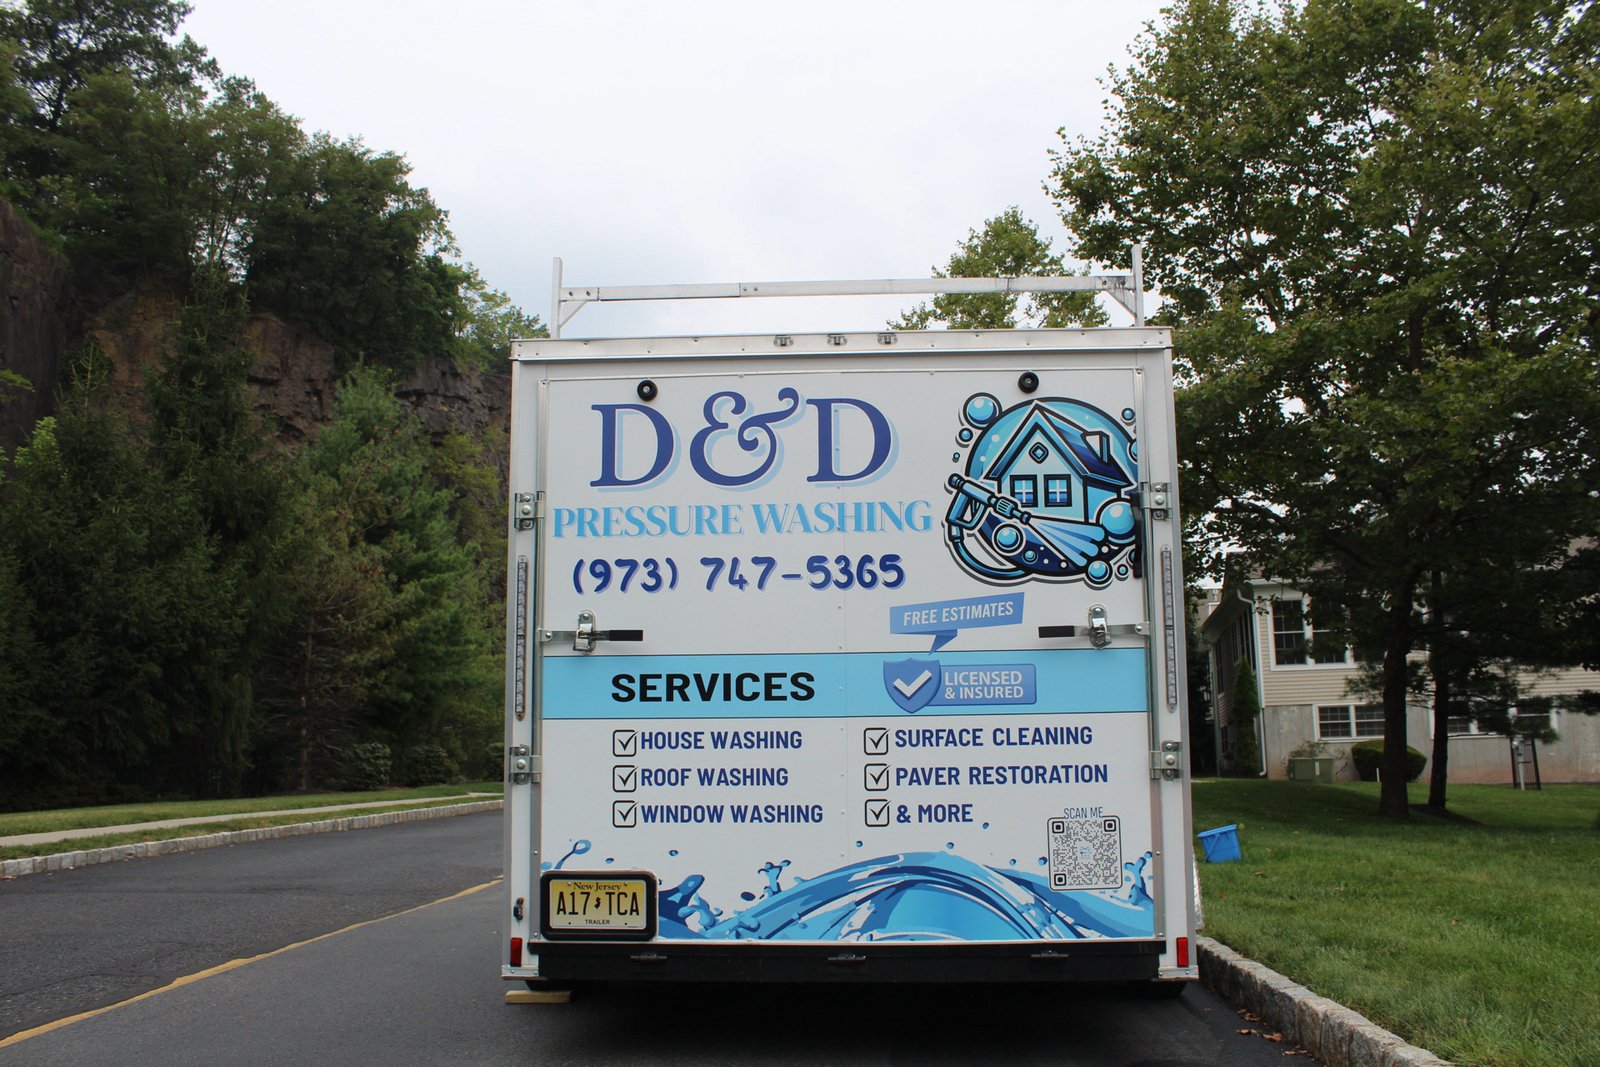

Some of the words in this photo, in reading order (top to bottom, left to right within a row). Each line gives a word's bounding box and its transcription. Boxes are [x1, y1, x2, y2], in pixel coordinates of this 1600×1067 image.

[589, 387, 899, 491] D&D
[553, 503, 745, 539] PRESSURE
[751, 500, 933, 537] WASHING
[573, 557, 679, 594] (973)
[700, 554, 906, 592] 747-5365
[903, 611, 937, 626] FREE
[942, 601, 1014, 623] ESTIMATES
[611, 672, 815, 702] SERVICES
[944, 670, 1022, 686] LICENSED
[944, 687, 956, 699] &
[959, 686, 1024, 699] INSURED
[641, 731, 705, 750] HOUSE
[710, 731, 803, 749] WASHING
[895, 728, 984, 747] SURFACE
[992, 726, 1093, 746] CLEANING
[641, 768, 692, 786] ROOF
[697, 767, 789, 786] WASHING
[896, 767, 960, 786] PAVER
[969, 764, 1108, 784] RESTORATION
[641, 805, 725, 823] WINDOW
[730, 804, 824, 823] WASHING
[896, 805, 911, 823] &
[918, 804, 973, 823] MORE
[1064, 807, 1088, 819] SCAN
[1090, 806, 1103, 818] ME
[573, 882, 594, 890] New
[594, 882, 621, 892] Jersey
[557, 891, 591, 915] A17
[605, 892, 639, 916] TCA
